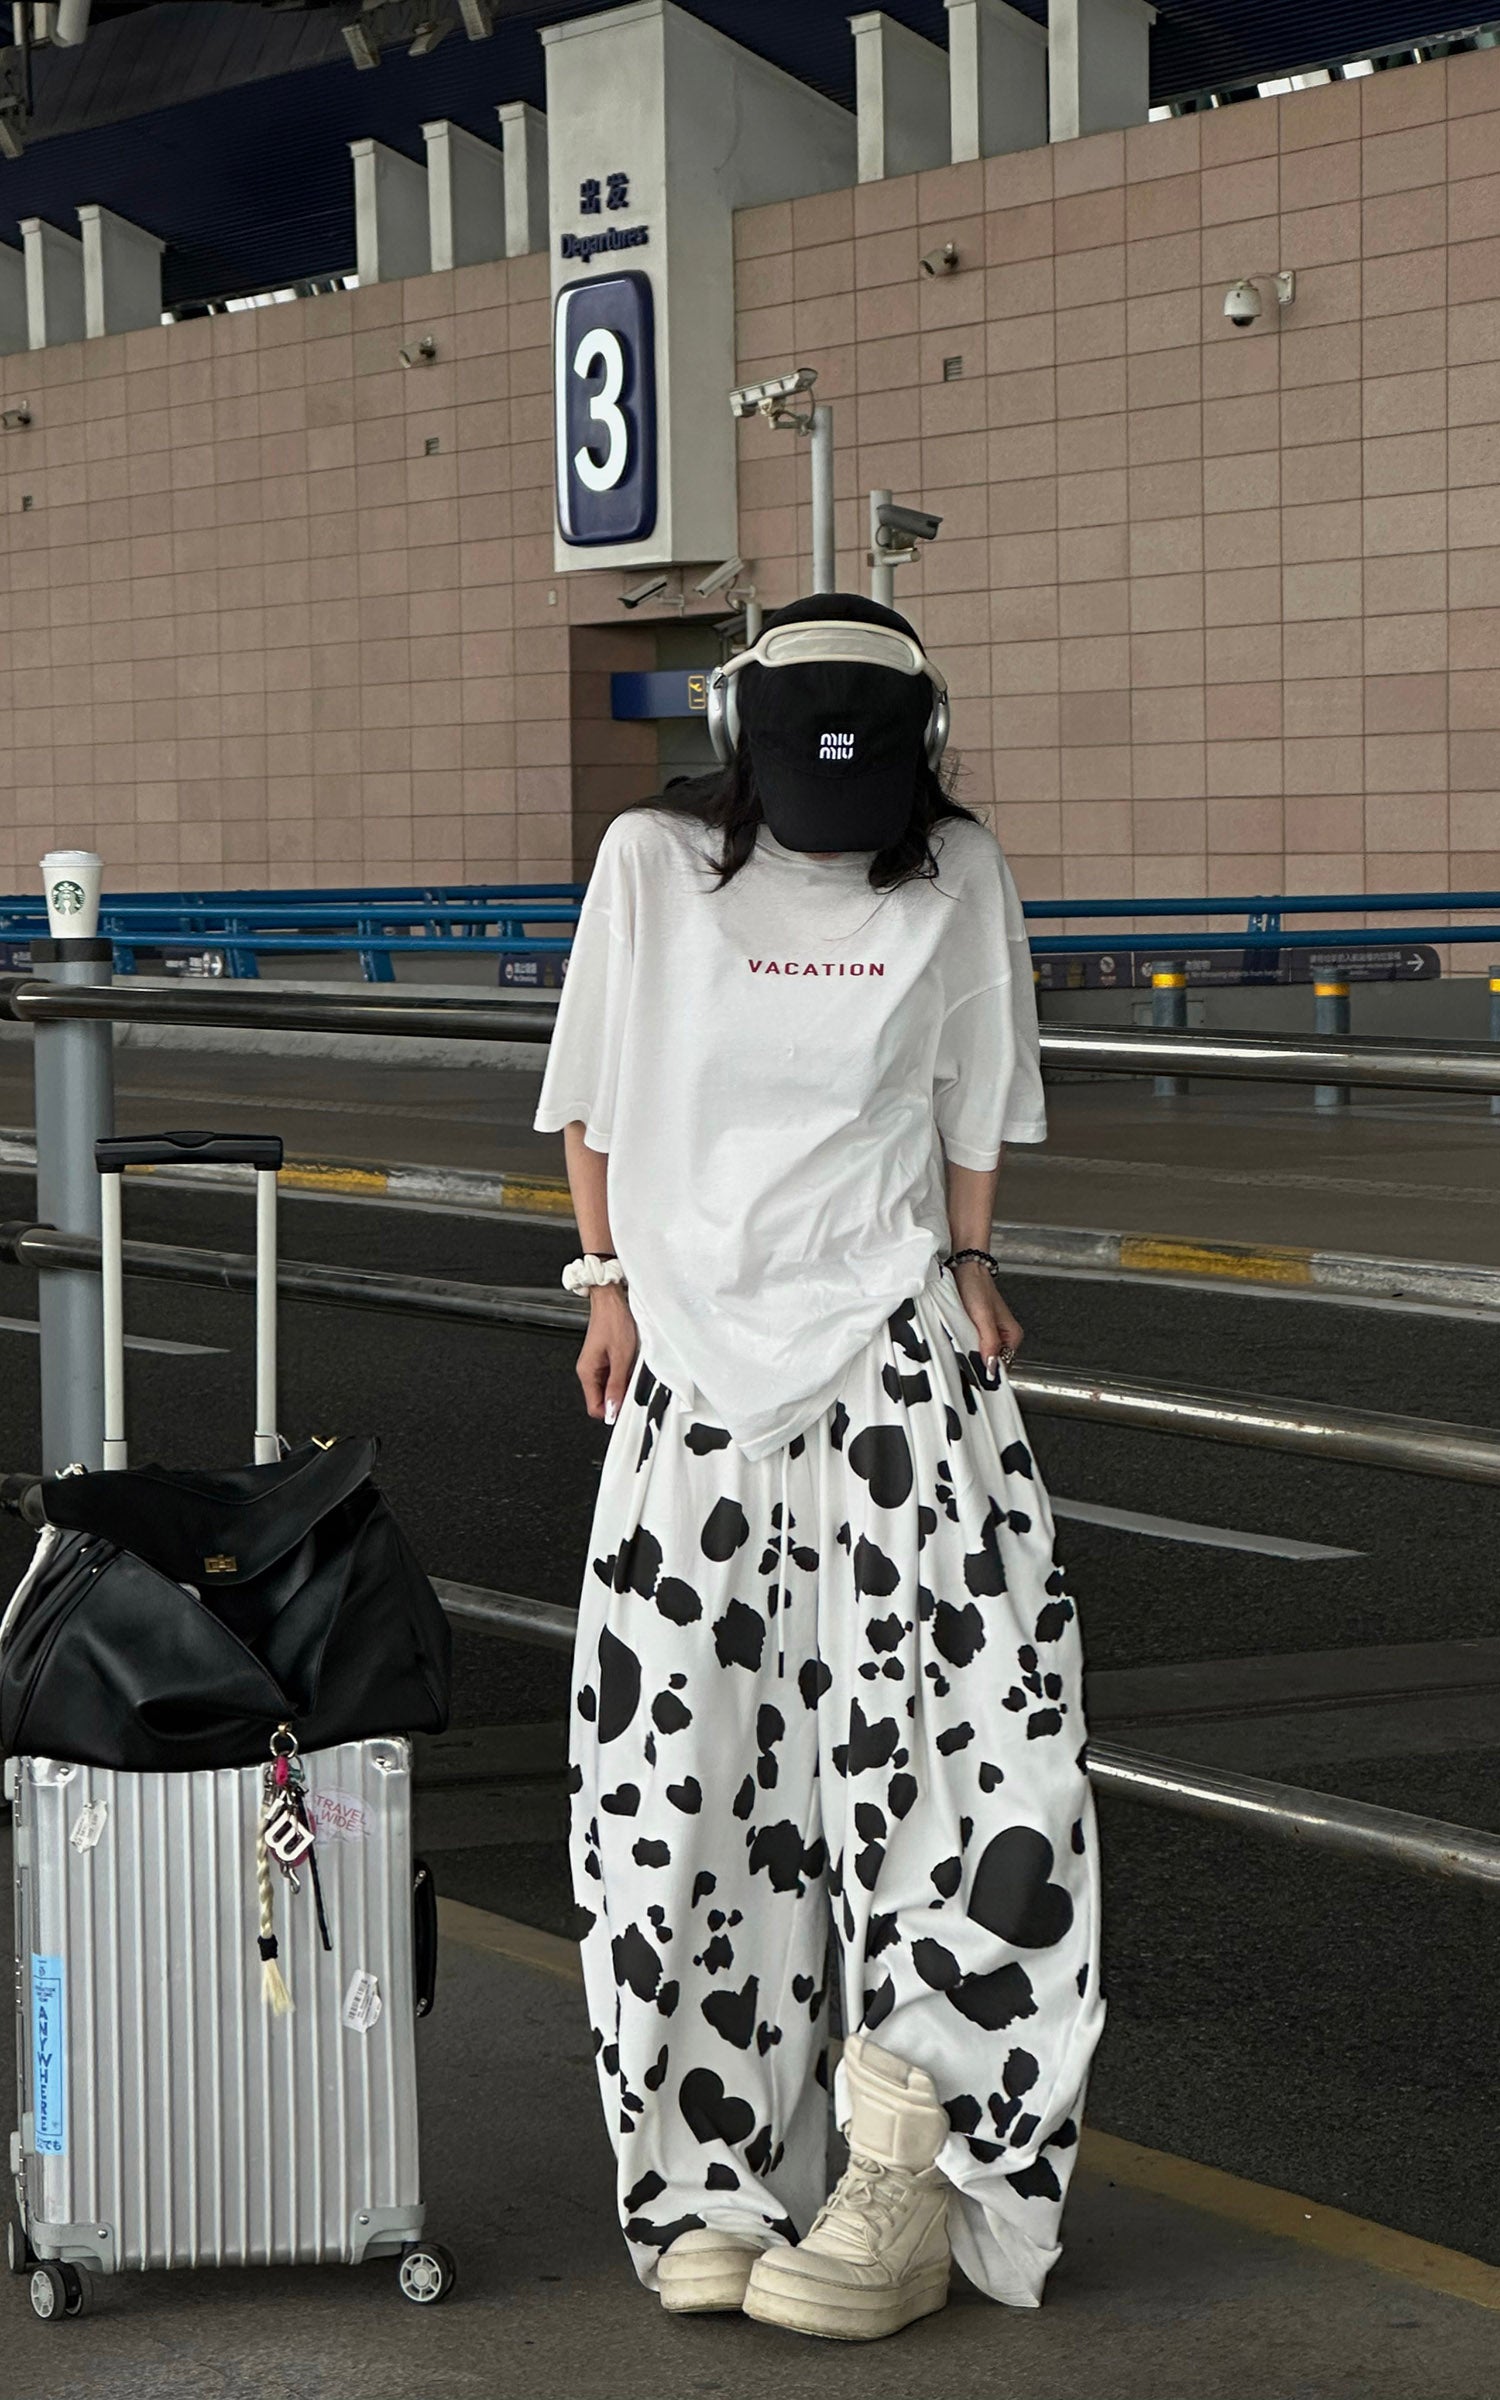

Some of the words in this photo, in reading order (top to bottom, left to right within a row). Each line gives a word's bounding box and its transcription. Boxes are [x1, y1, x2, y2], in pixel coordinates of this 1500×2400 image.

[579, 171, 630, 215] 出发
[560, 224, 649, 263] Departures
[573, 328, 628, 492] 3
[748, 959, 885, 976] VACATION
[315, 1794, 367, 1825] TRAVEL
[37, 2006, 53, 2132] ANYWHERE
